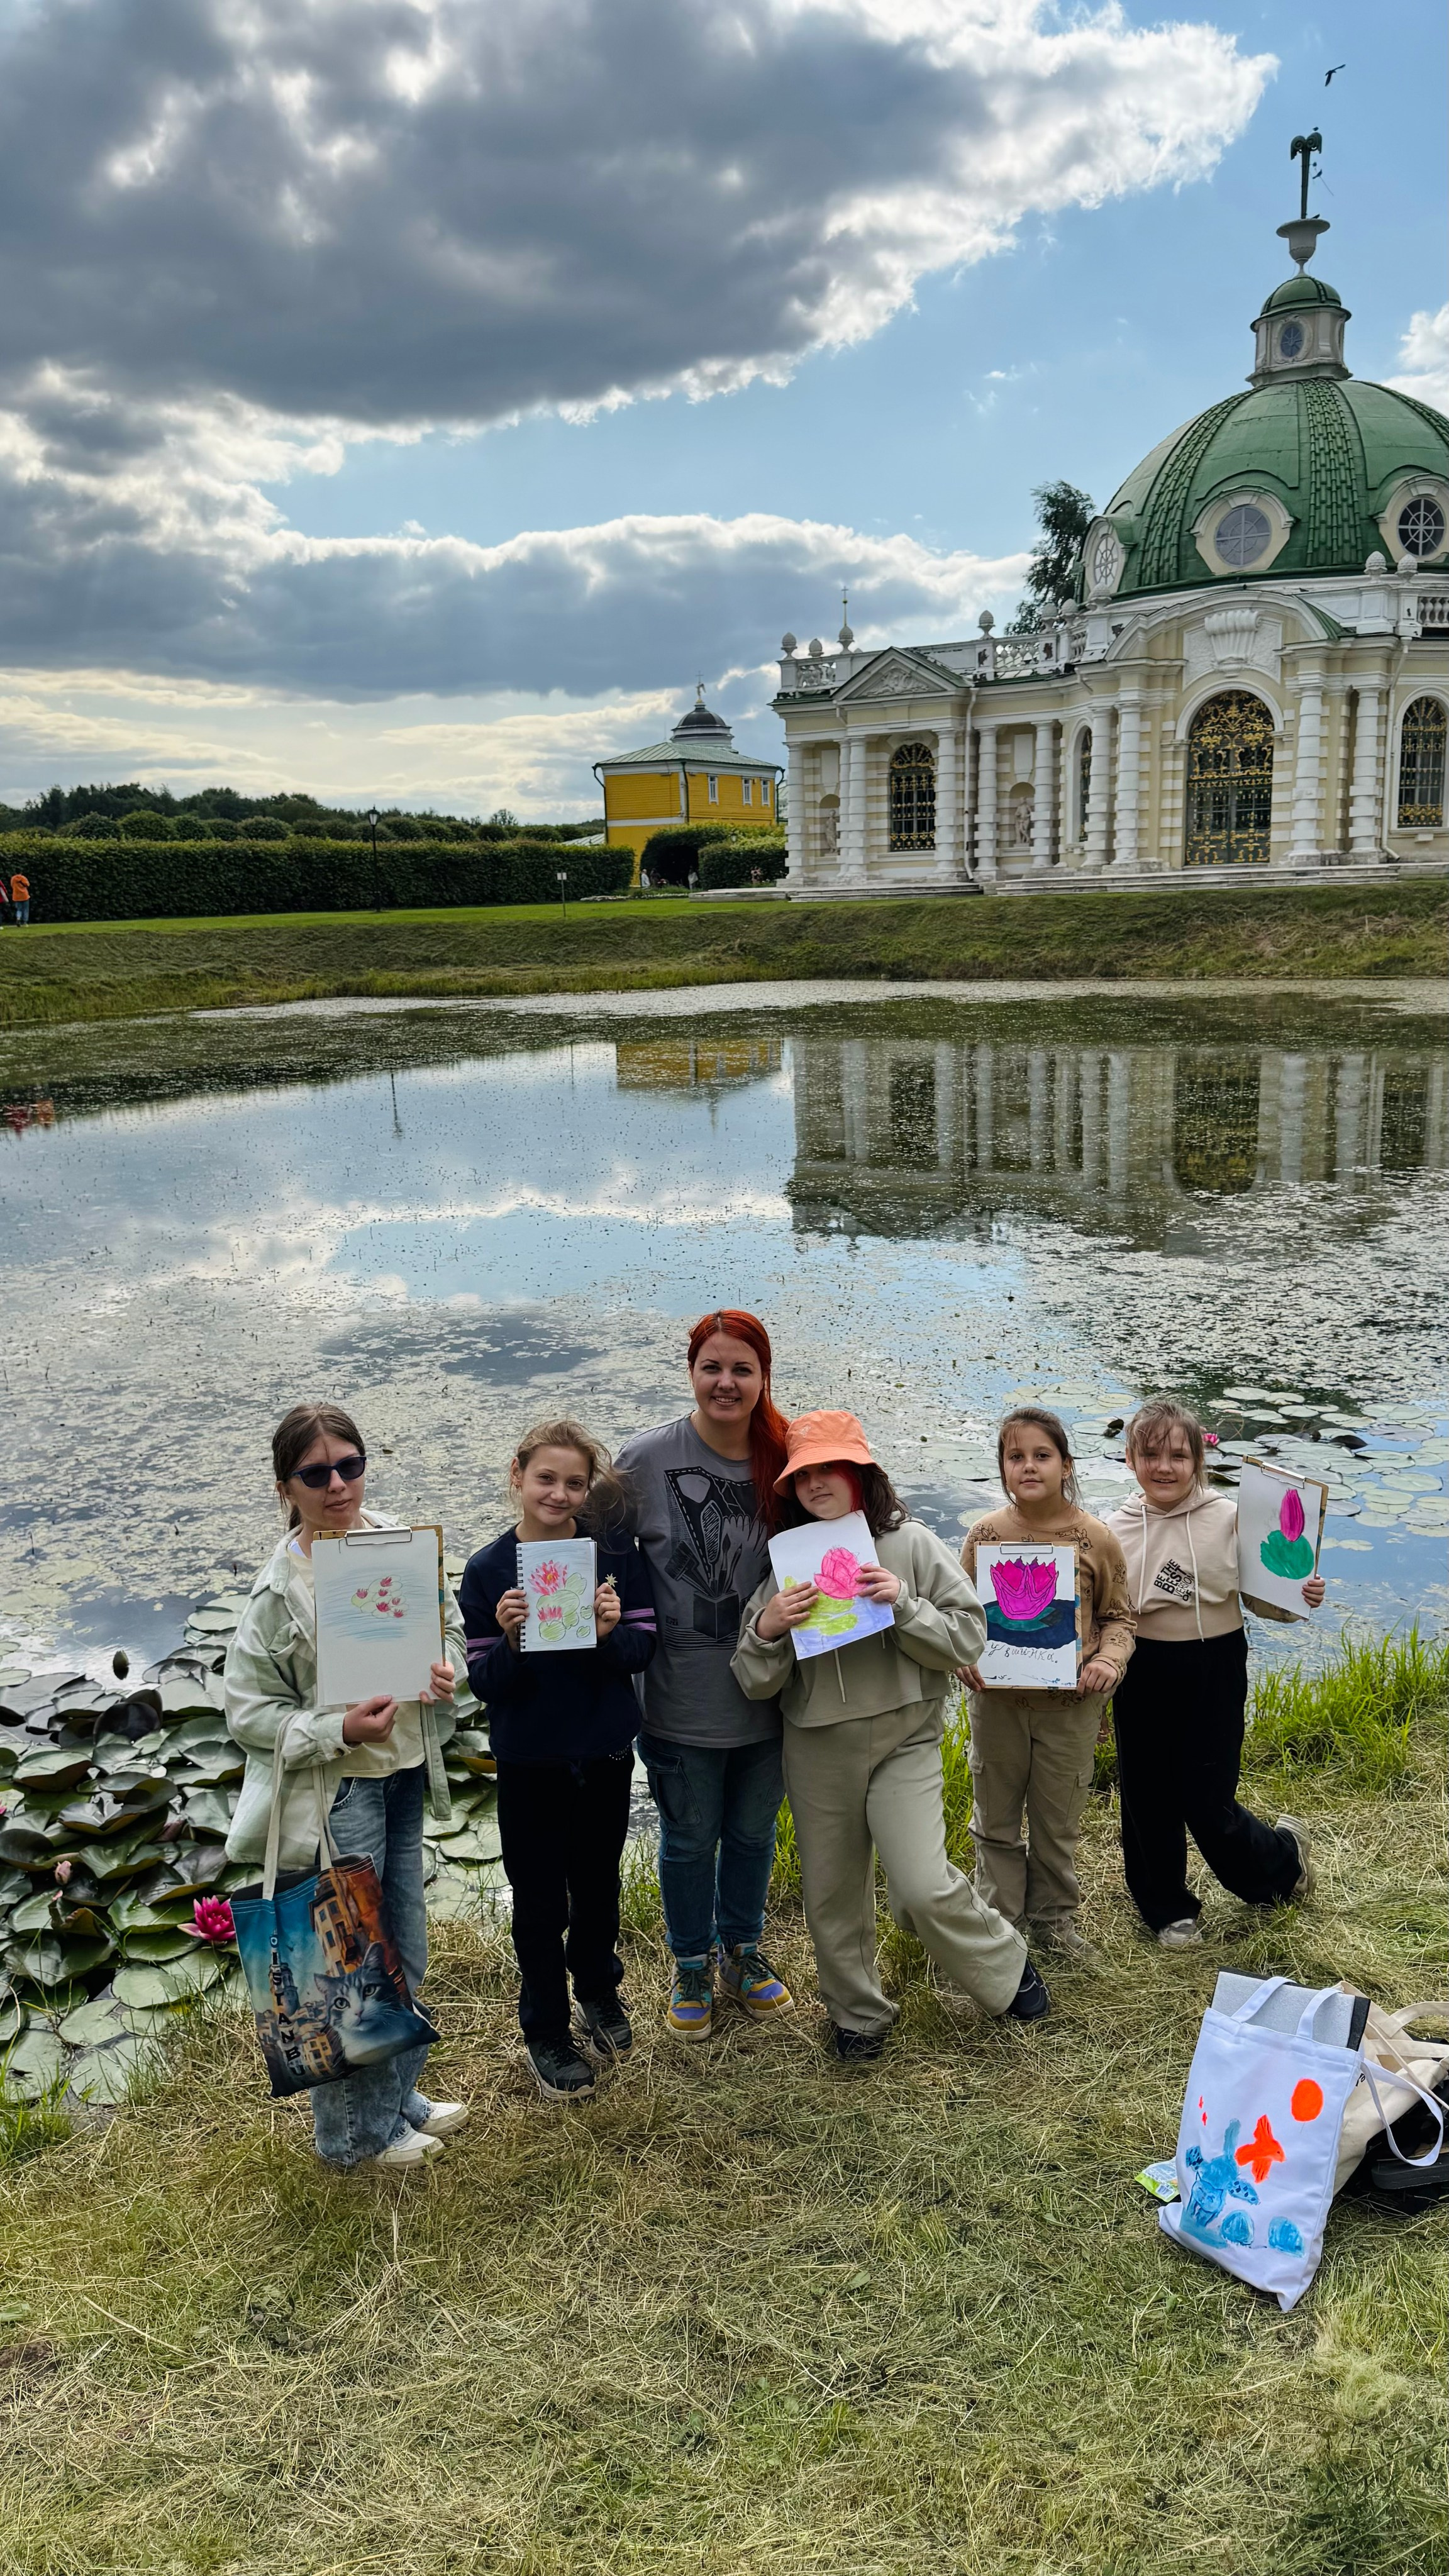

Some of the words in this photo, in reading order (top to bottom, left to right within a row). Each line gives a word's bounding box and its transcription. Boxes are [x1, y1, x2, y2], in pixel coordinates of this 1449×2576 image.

[1153, 1574, 1165, 1588] BE
[1160, 1559, 1178, 1576] THE
[1161, 1565, 1187, 1594] BEST
[1182, 1589, 1192, 1601] OF
